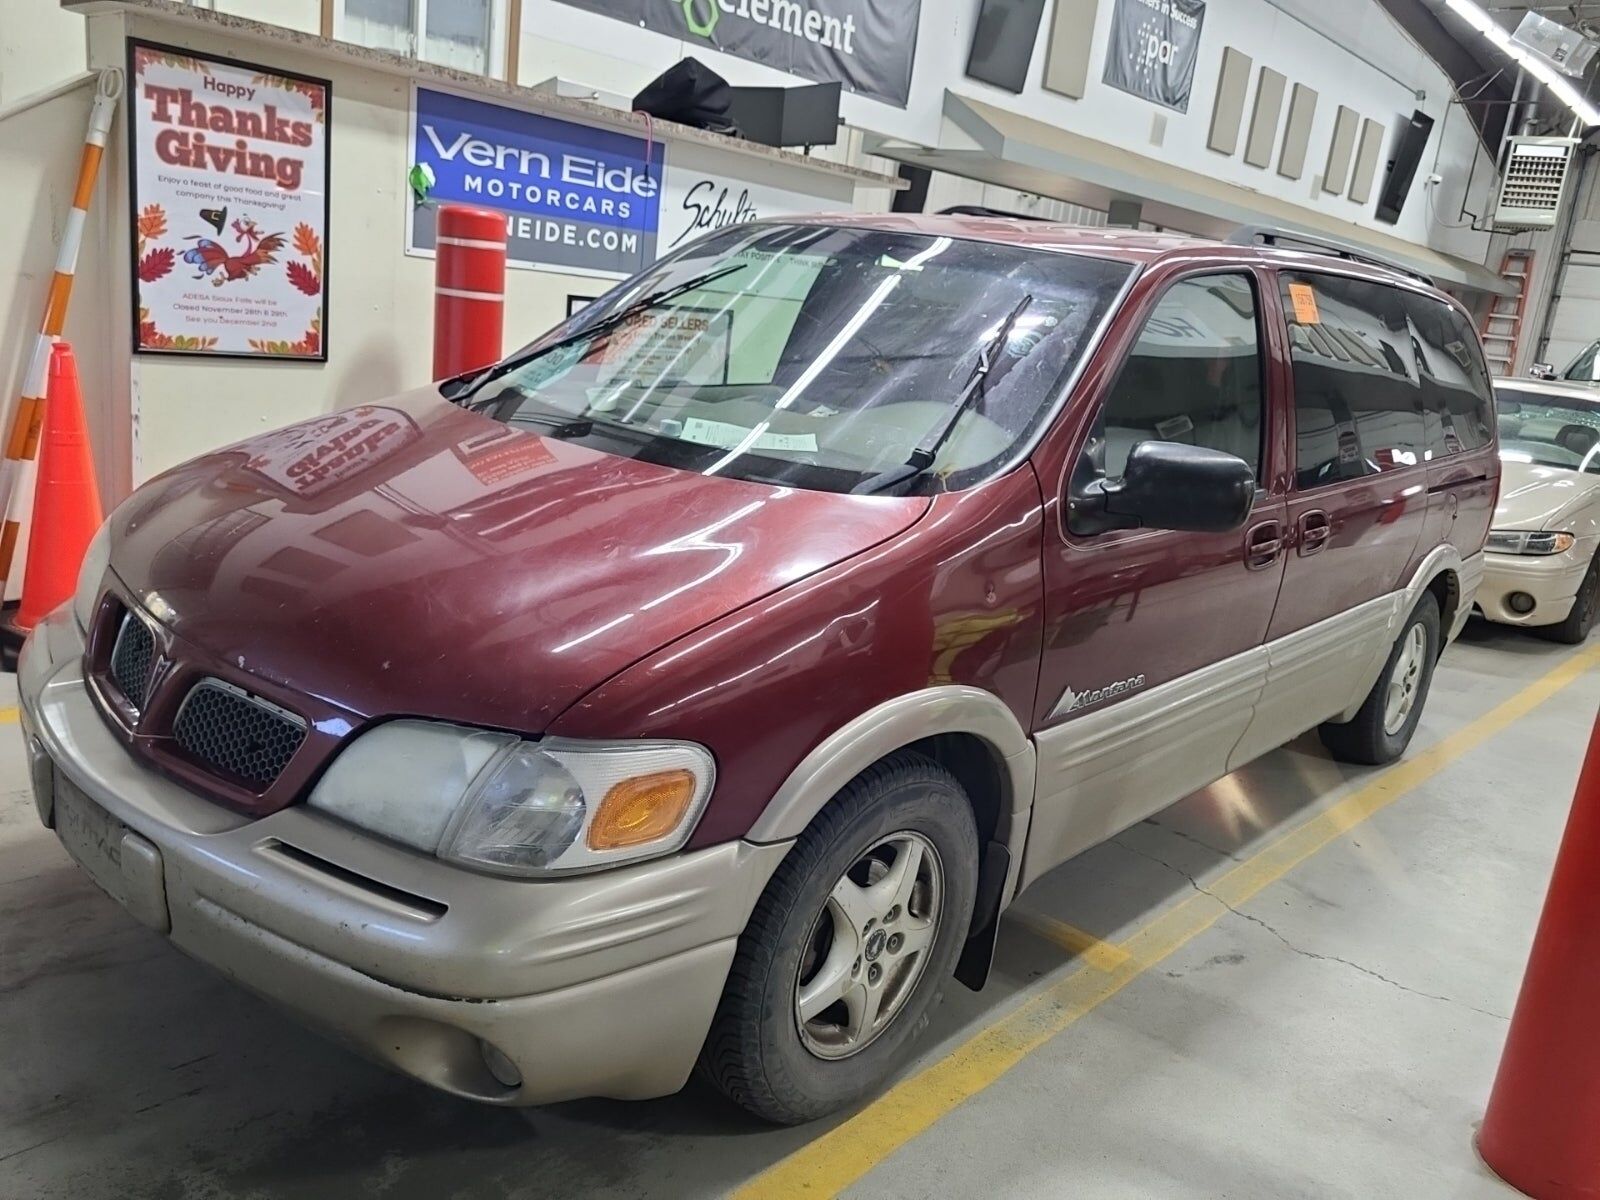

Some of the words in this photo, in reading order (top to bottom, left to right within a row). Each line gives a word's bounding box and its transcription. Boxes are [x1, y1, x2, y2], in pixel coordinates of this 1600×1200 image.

[1170, 3, 1198, 29] Success
[1145, 35, 1179, 66] par
[203, 76, 256, 101] Happy
[144, 83, 313, 147] Thanks
[155, 129, 304, 191] Giving
[423, 124, 551, 179] Vern
[561, 154, 657, 198] Eide
[158, 175, 181, 185] Enjoy
[191, 179, 211, 188] feast
[223, 185, 244, 193] good
[245, 187, 262, 196] food
[176, 190, 214, 201] company
[217, 195, 231, 203] this
[464, 174, 631, 218] MOTORCARS
[173, 303, 200, 311] Closed
[202, 306, 242, 315] November
[1060, 674, 1145, 715] Montana
